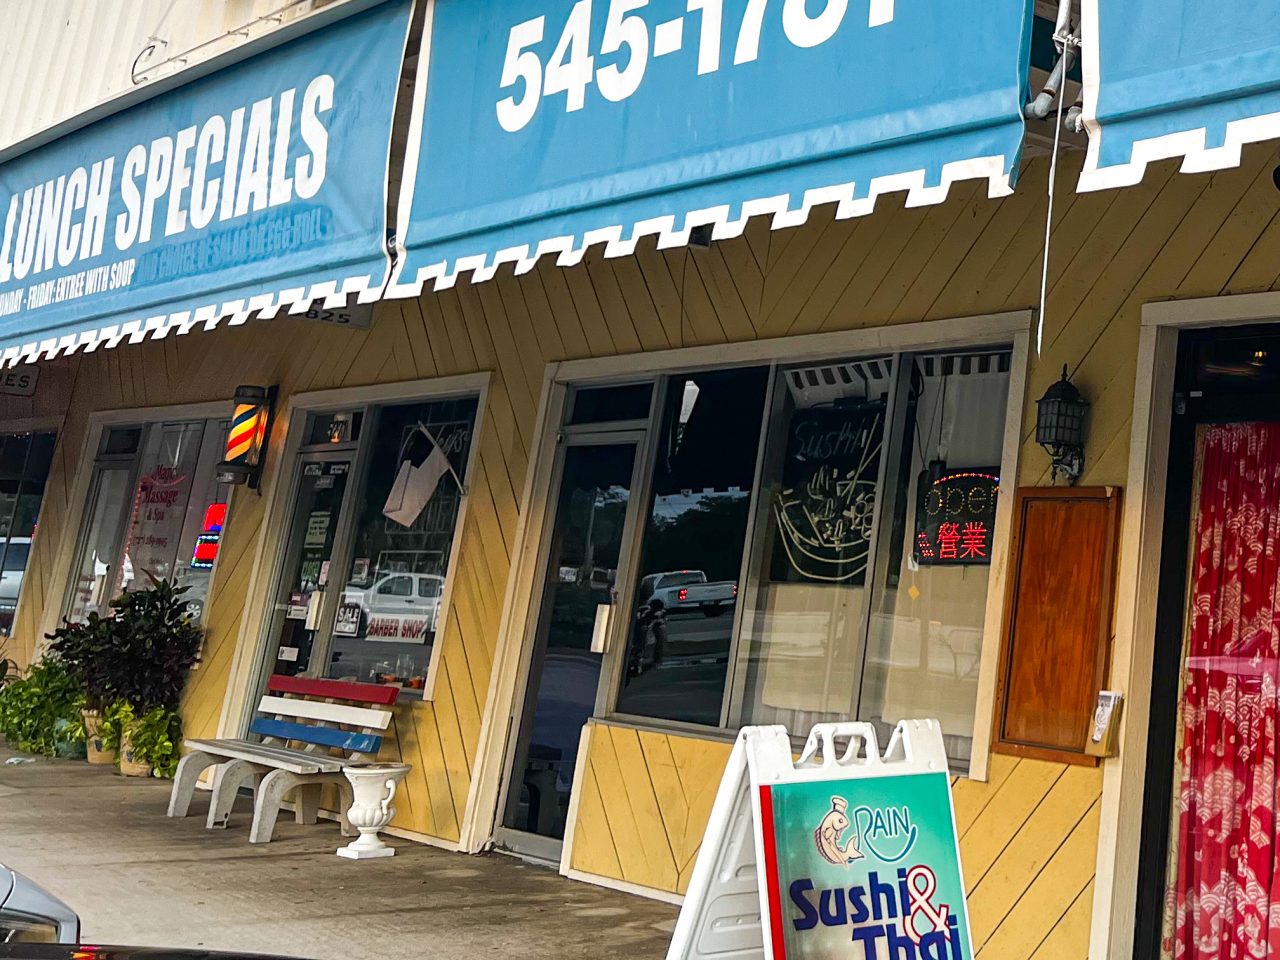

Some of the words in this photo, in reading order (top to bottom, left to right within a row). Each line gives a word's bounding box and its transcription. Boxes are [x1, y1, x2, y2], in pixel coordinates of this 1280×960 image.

[0, 156, 115, 283] LUNCH
[115, 74, 335, 251] SPECIALS
[0, 288, 24, 317] ONDAY
[55, 271, 85, 303] ENTREE
[85, 265, 110, 296] WITH
[109, 258, 136, 290] SOUP
[0, 373, 30, 388] ES
[936, 521, 987, 559] 營業
[338, 608, 360, 623] SALE
[368, 617, 400, 638] BARBER
[401, 618, 425, 639] SHOP
[854, 806, 918, 863] RAIN
[789, 868, 912, 932] Sushi
[852, 914, 963, 960] Thai
